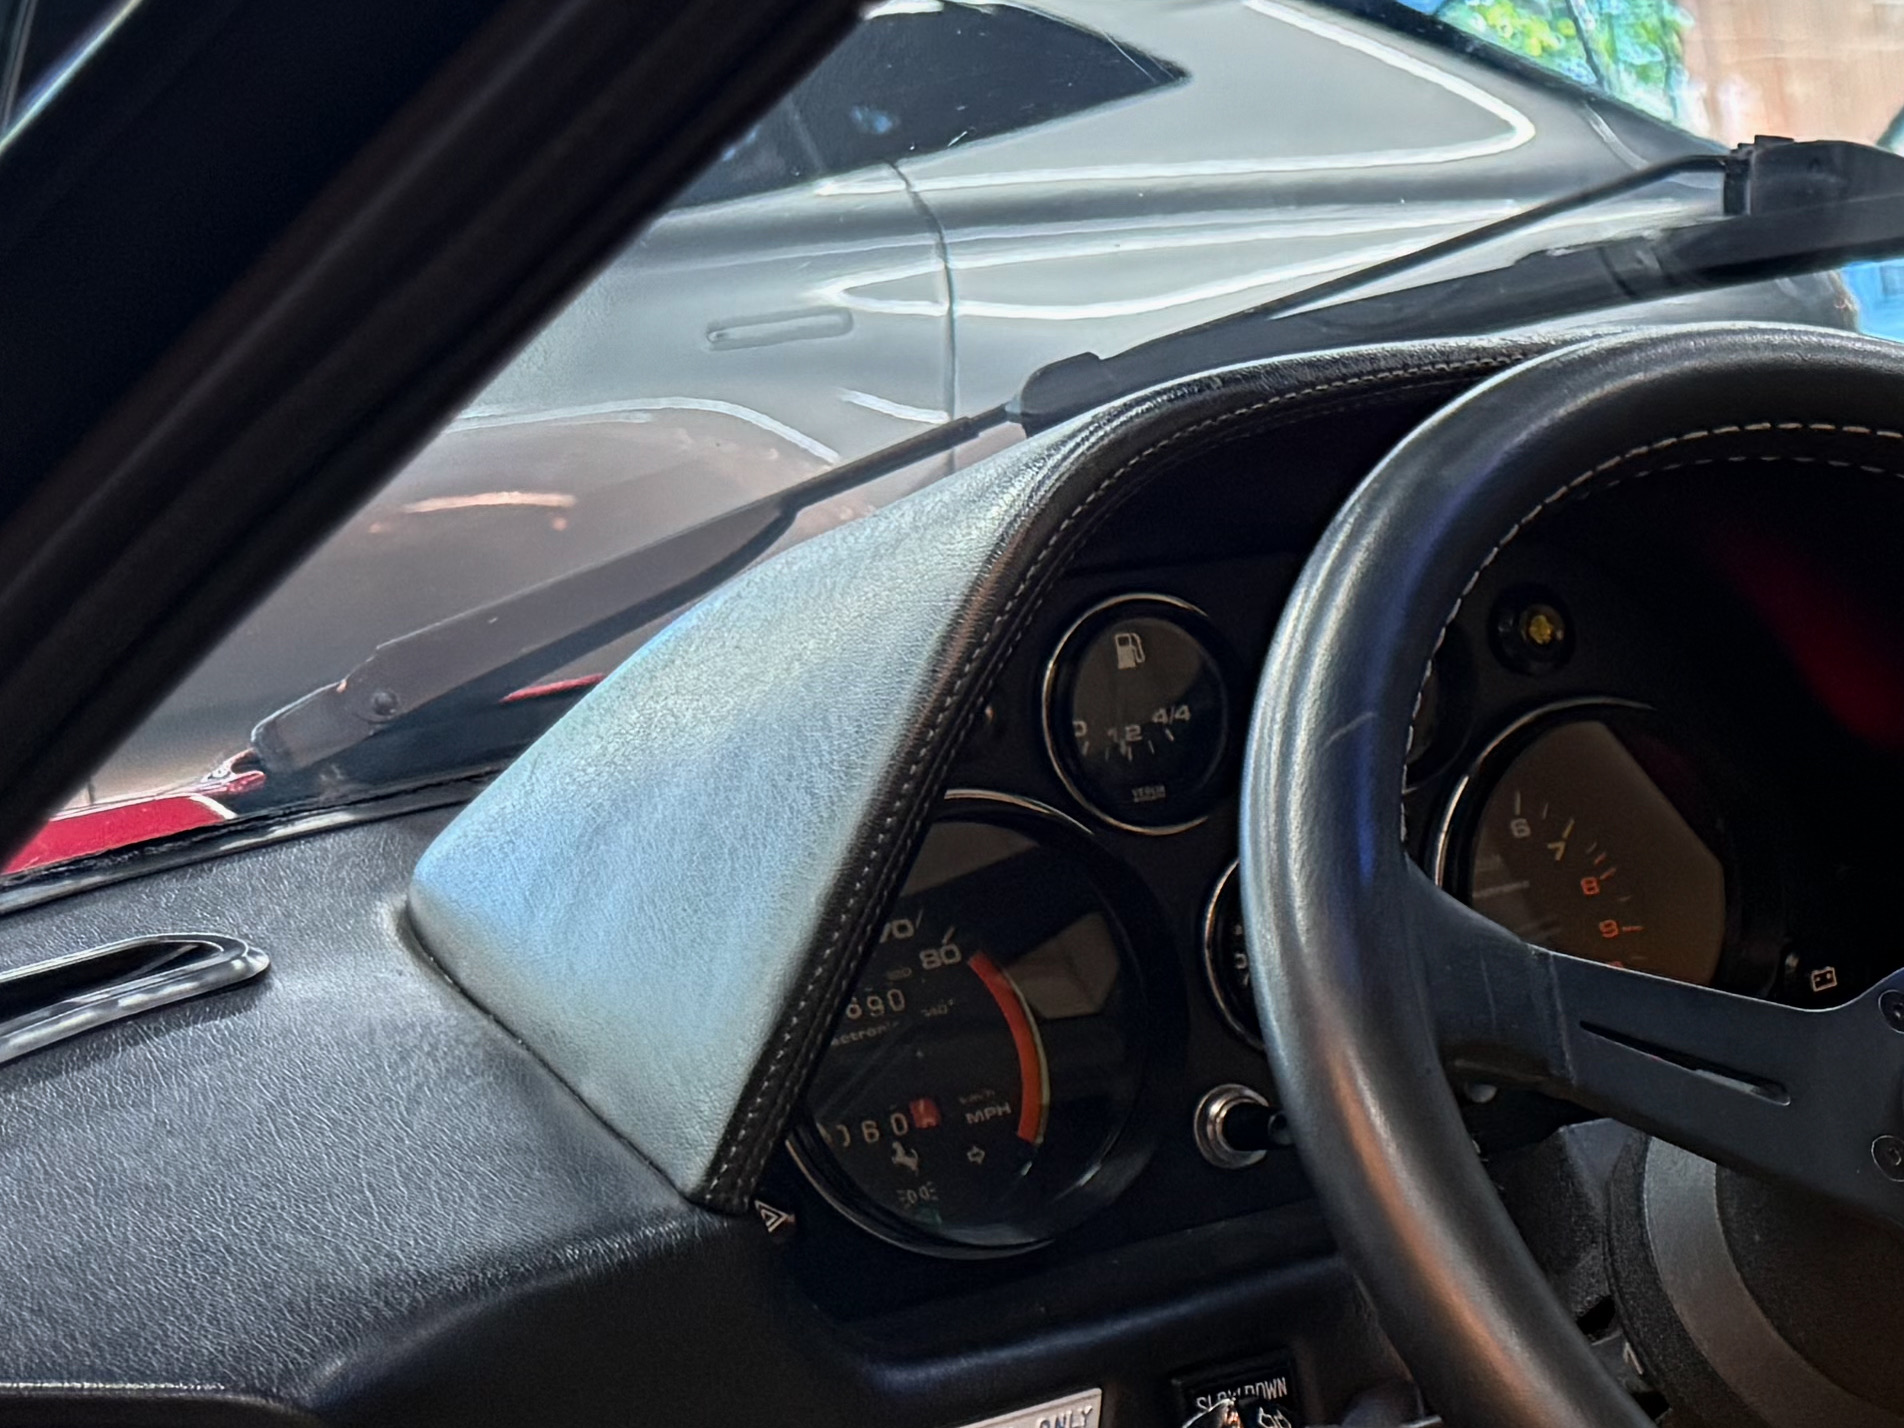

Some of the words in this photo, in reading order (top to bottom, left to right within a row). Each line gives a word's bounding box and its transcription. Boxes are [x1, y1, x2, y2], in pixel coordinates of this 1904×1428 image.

[1151, 704, 1192, 725] 4/4
[1509, 818, 1532, 840] 6
[1547, 841, 1566, 861] 7
[1580, 876, 1600, 895] 8
[1598, 918, 1620, 939] 9
[918, 943, 963, 971] 80
[964, 1101, 1012, 1125] MPH
